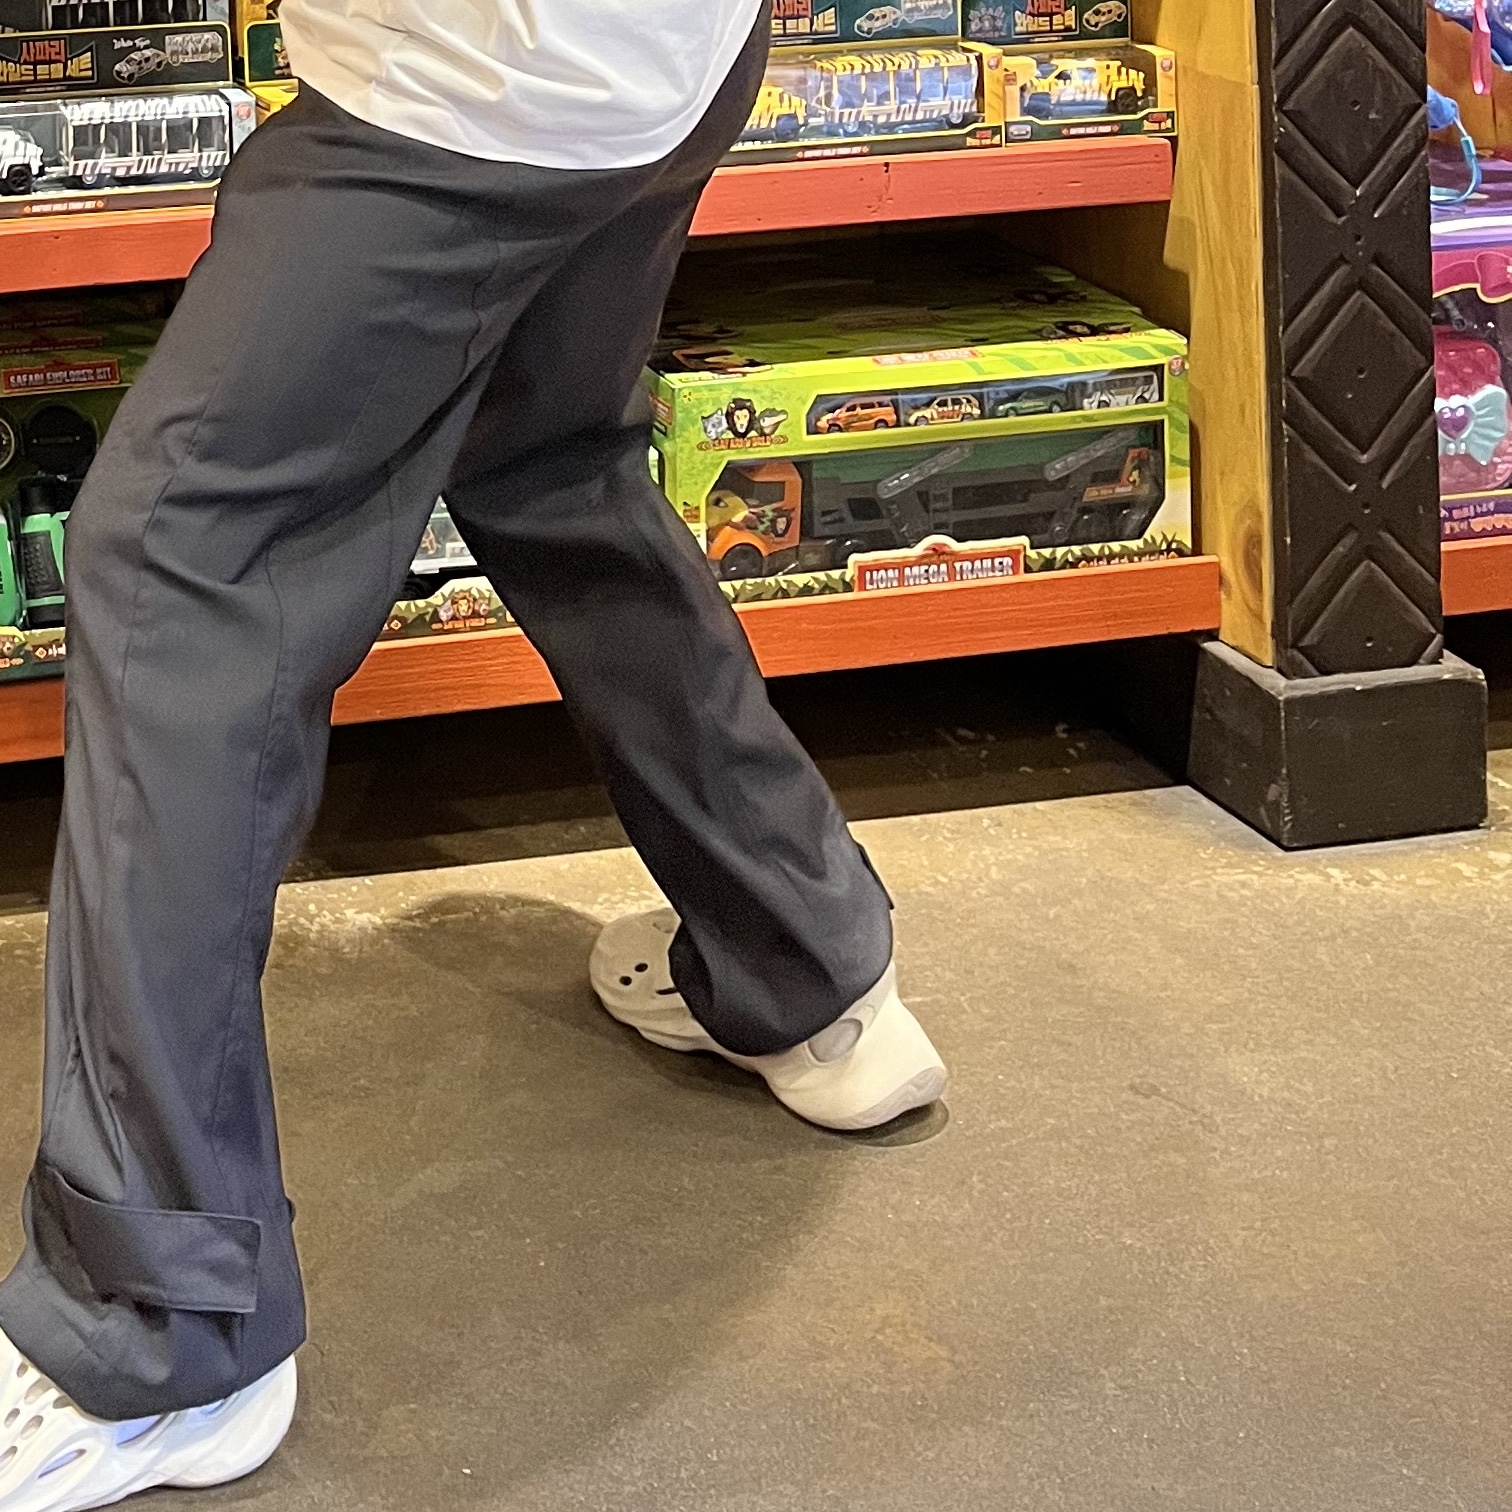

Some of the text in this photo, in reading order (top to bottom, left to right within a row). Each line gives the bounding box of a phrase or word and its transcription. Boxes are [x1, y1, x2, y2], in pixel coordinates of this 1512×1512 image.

[813, 7, 836, 33] 세트
[20, 40, 65, 63] 사파리
[66, 51, 93, 78] 세트
[10, 367, 112, 387] SAFARI EXPLORER KIT
[865, 557, 1013, 590] LION MEGA TRAILER
